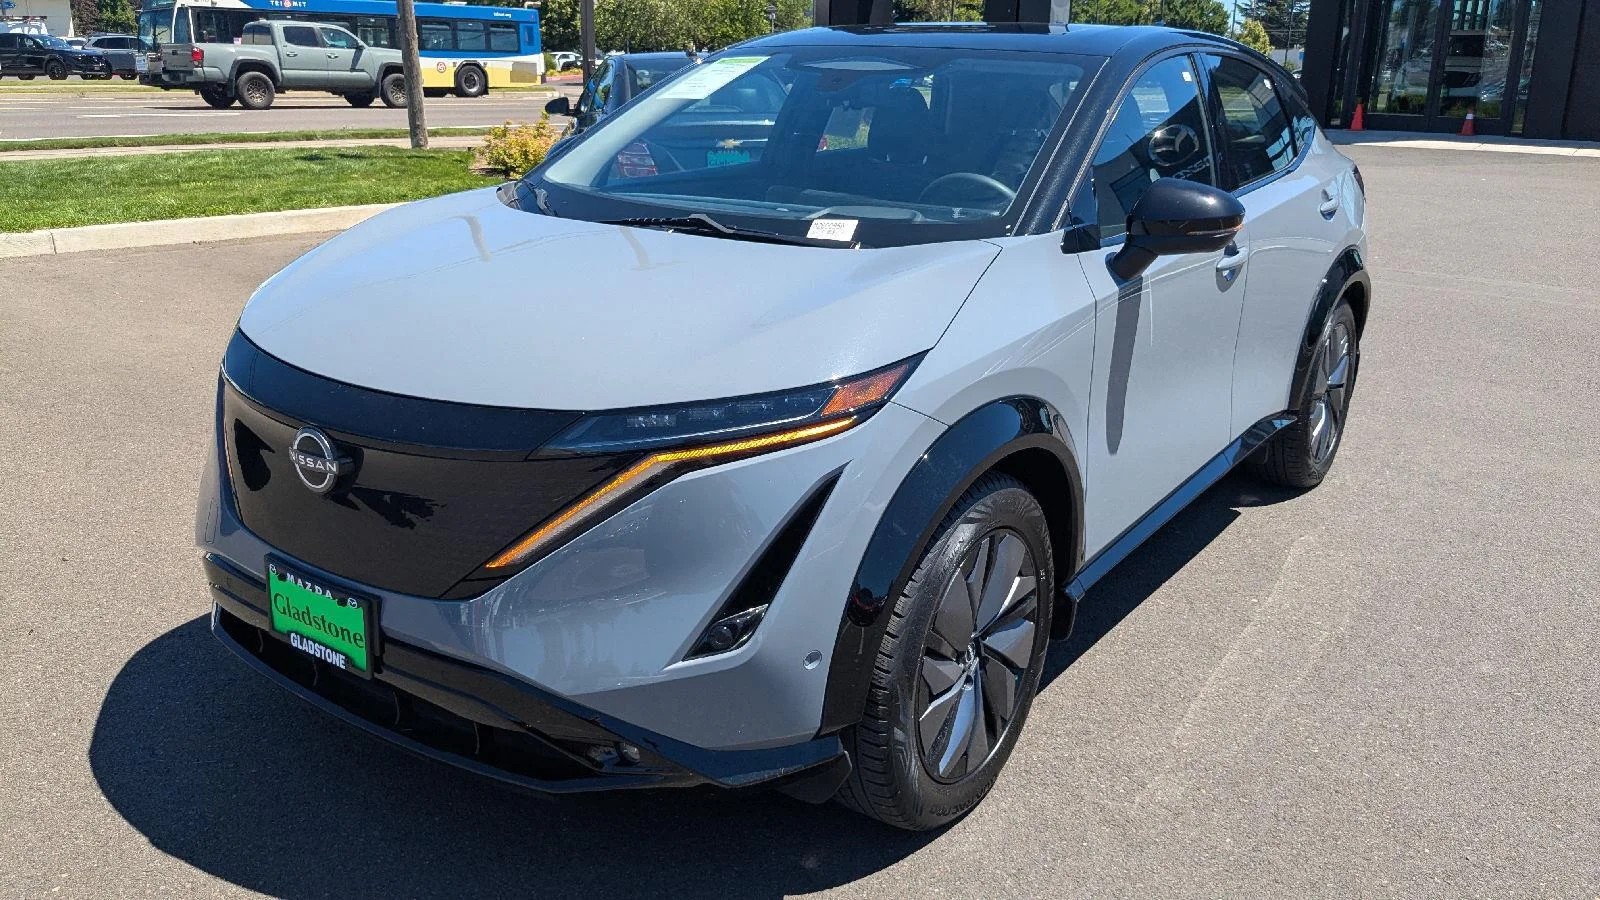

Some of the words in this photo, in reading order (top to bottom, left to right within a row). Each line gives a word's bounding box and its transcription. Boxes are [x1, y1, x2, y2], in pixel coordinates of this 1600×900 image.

[289, 446, 337, 472] NISSAN
[286, 573, 333, 600] MAZDA
[273, 592, 364, 649] Gladstone
[290, 632, 346, 670] GLADSTONE
